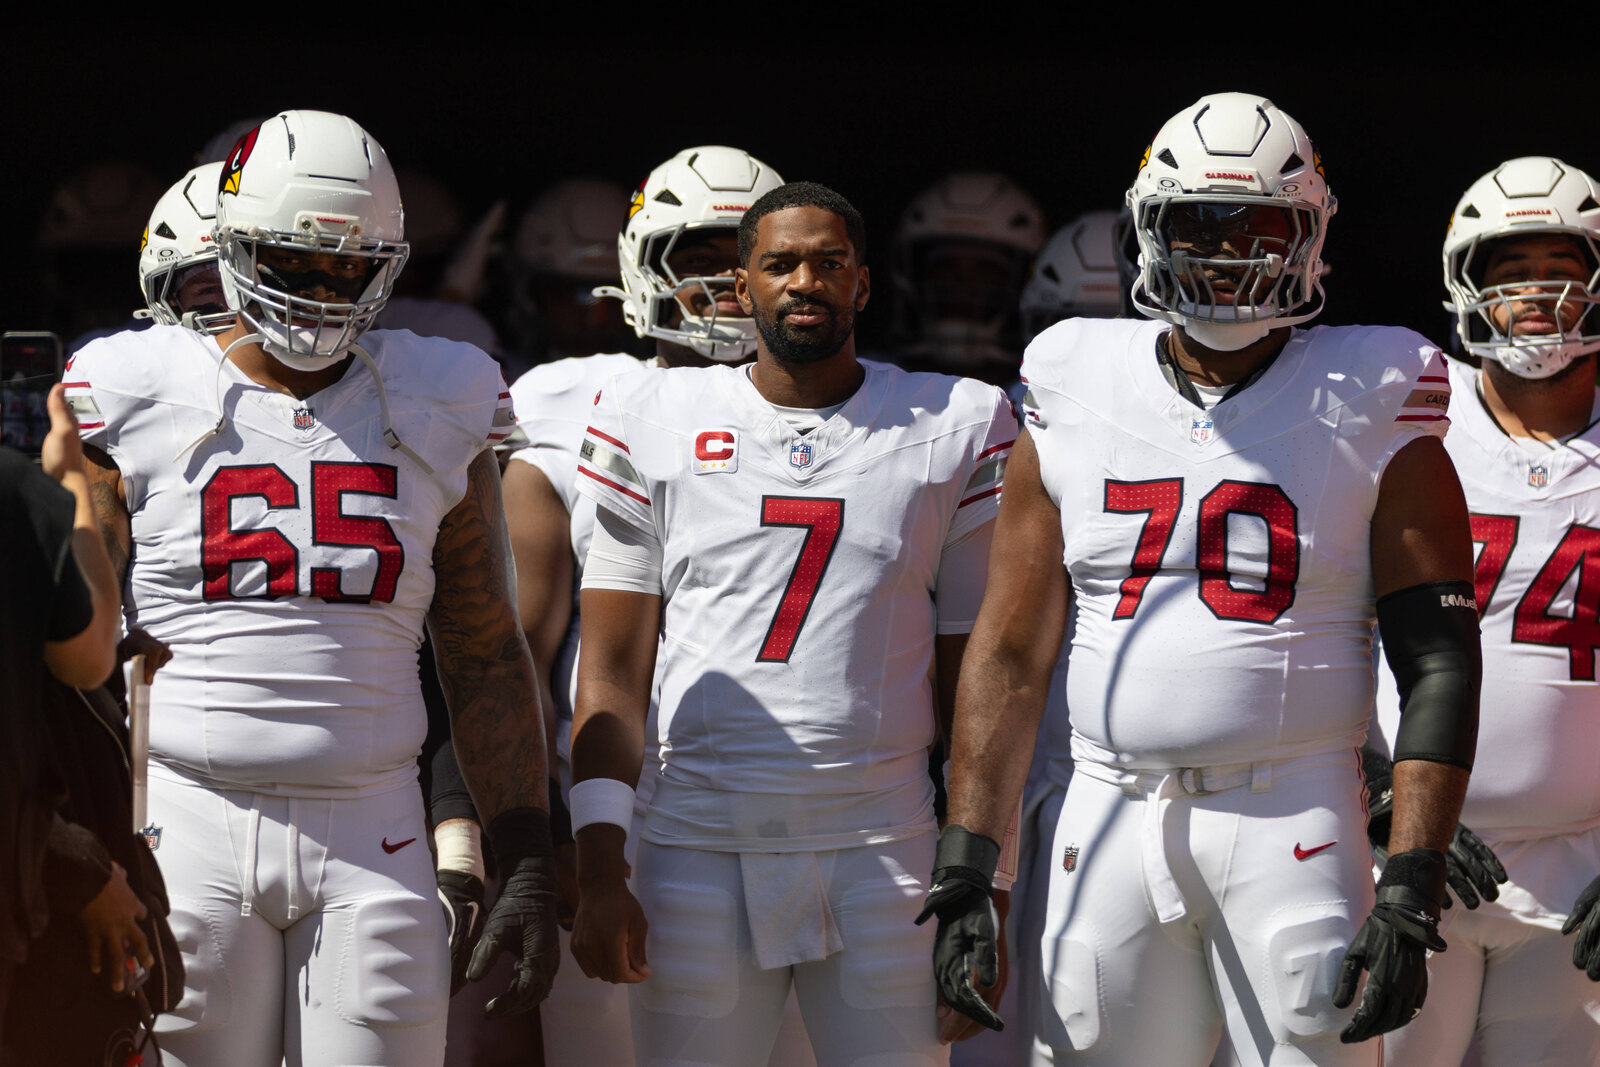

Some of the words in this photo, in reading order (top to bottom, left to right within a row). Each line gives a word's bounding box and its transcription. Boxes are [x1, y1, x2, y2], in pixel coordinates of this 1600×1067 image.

[1505, 209, 1551, 217] CARDINALS
[295, 415, 314, 427] NFL
[695, 431, 735, 461] C
[792, 452, 809, 464] NFL
[200, 460, 405, 604] 65
[1103, 477, 1300, 625] 70
[755, 495, 845, 664] 7
[1469, 512, 1600, 682] 74
